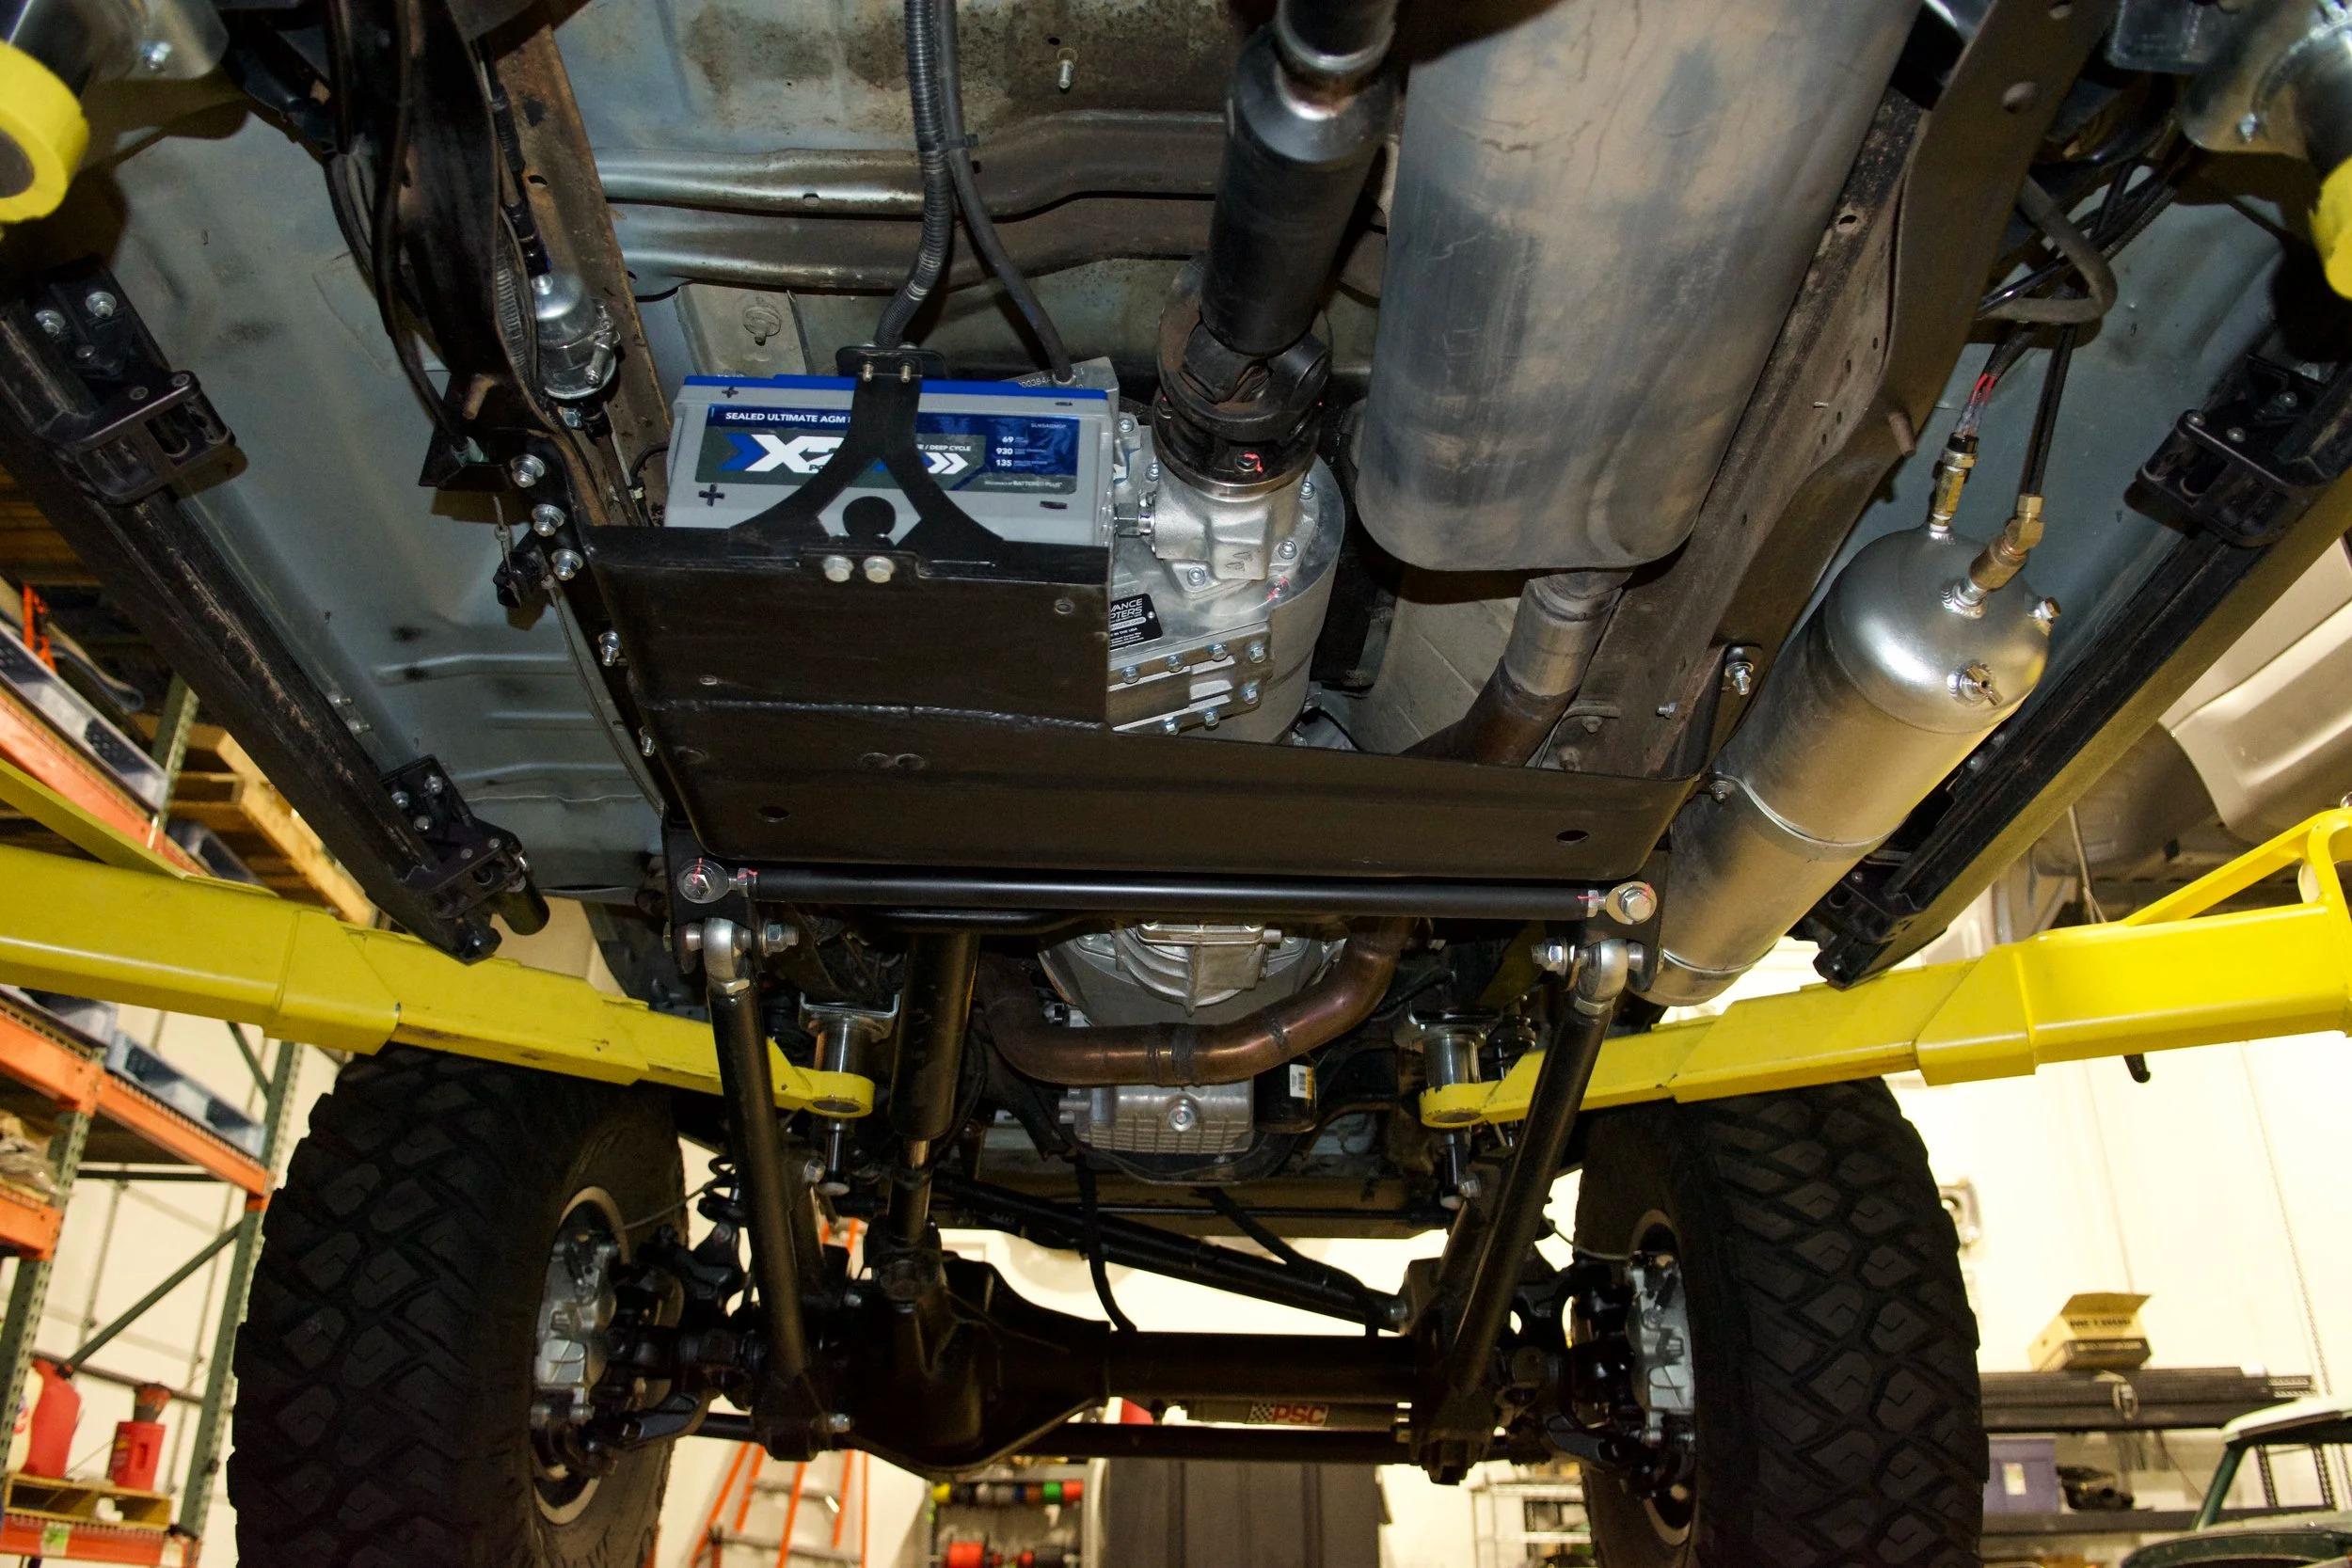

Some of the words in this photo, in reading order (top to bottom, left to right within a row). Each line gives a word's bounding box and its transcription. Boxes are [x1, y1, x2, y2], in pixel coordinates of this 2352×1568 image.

[725, 412, 765, 420] SEALED
[767, 413, 818, 422] ULTIMATE
[819, 415, 846, 423] AGM
[995, 447, 1013, 455] 930
[1273, 1404, 1326, 1424] PSC
